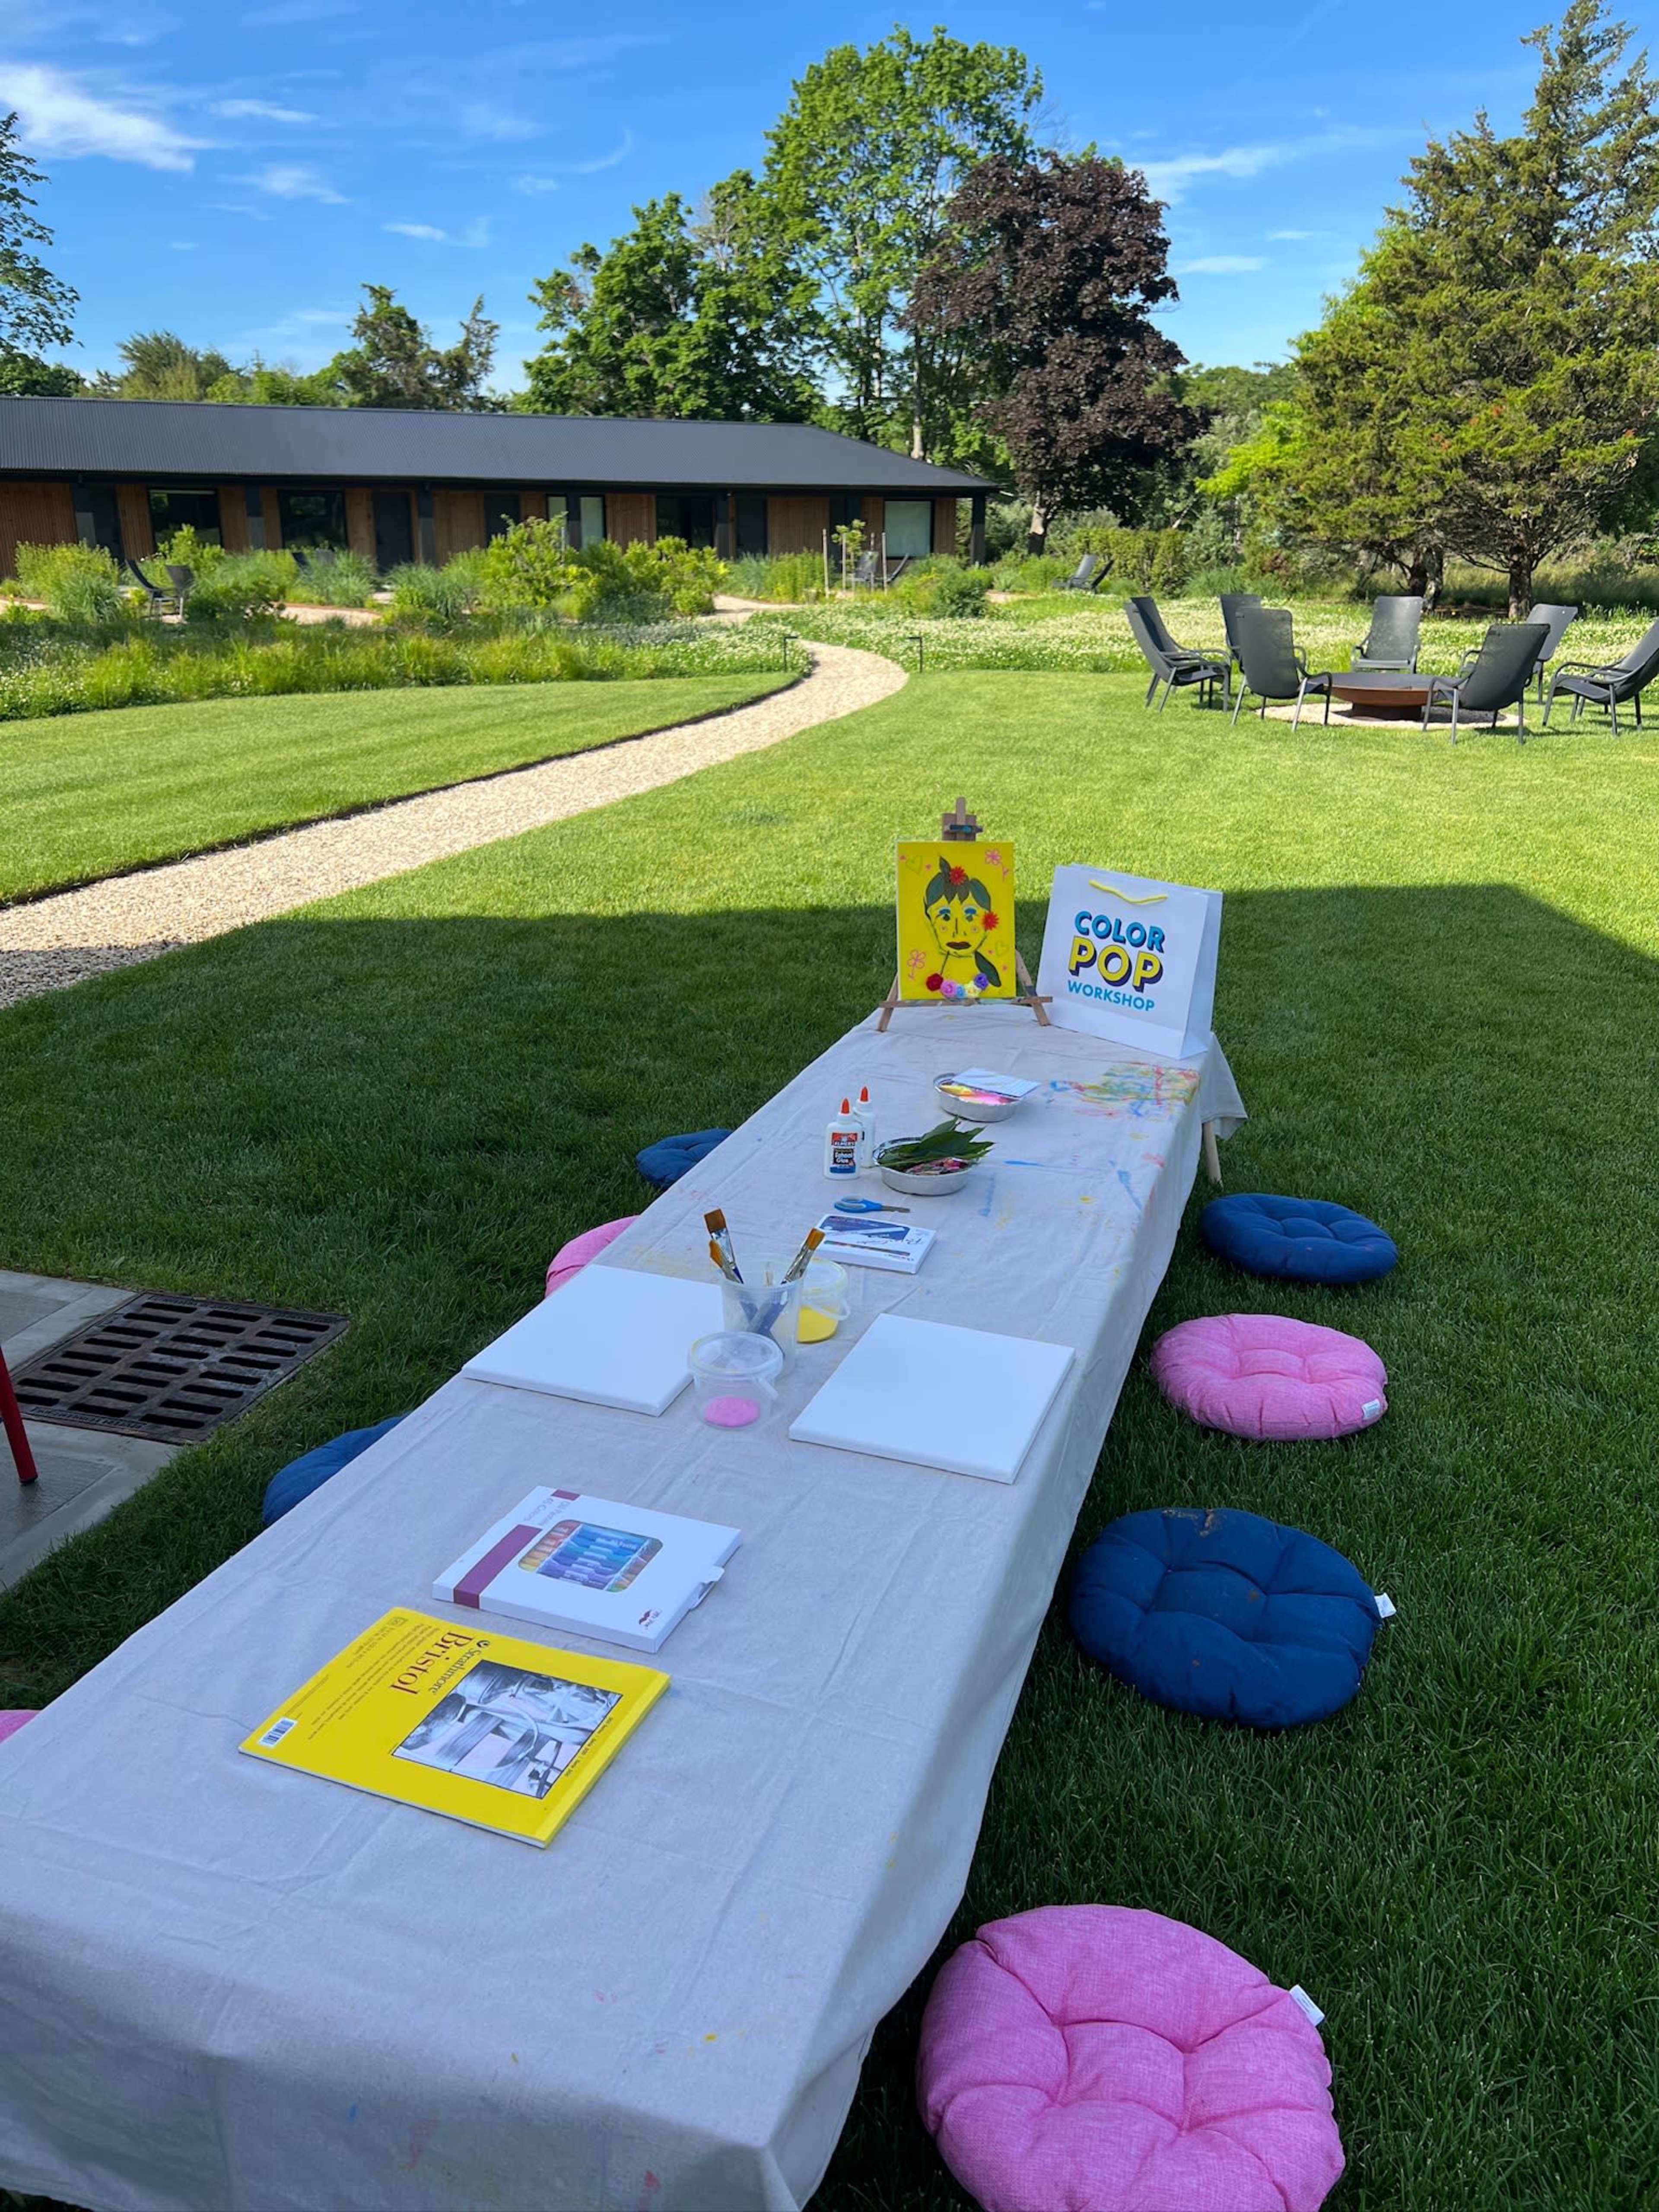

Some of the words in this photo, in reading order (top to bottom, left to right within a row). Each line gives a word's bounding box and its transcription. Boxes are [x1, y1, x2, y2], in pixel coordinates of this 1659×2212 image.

[1074, 911, 1165, 953] COLOR
[1069, 936, 1163, 993] POP
[1068, 980, 1155, 1011] WORKSHOP
[388, 1632, 474, 1694] Bristol
[428, 1648, 482, 1694] Strathmore
